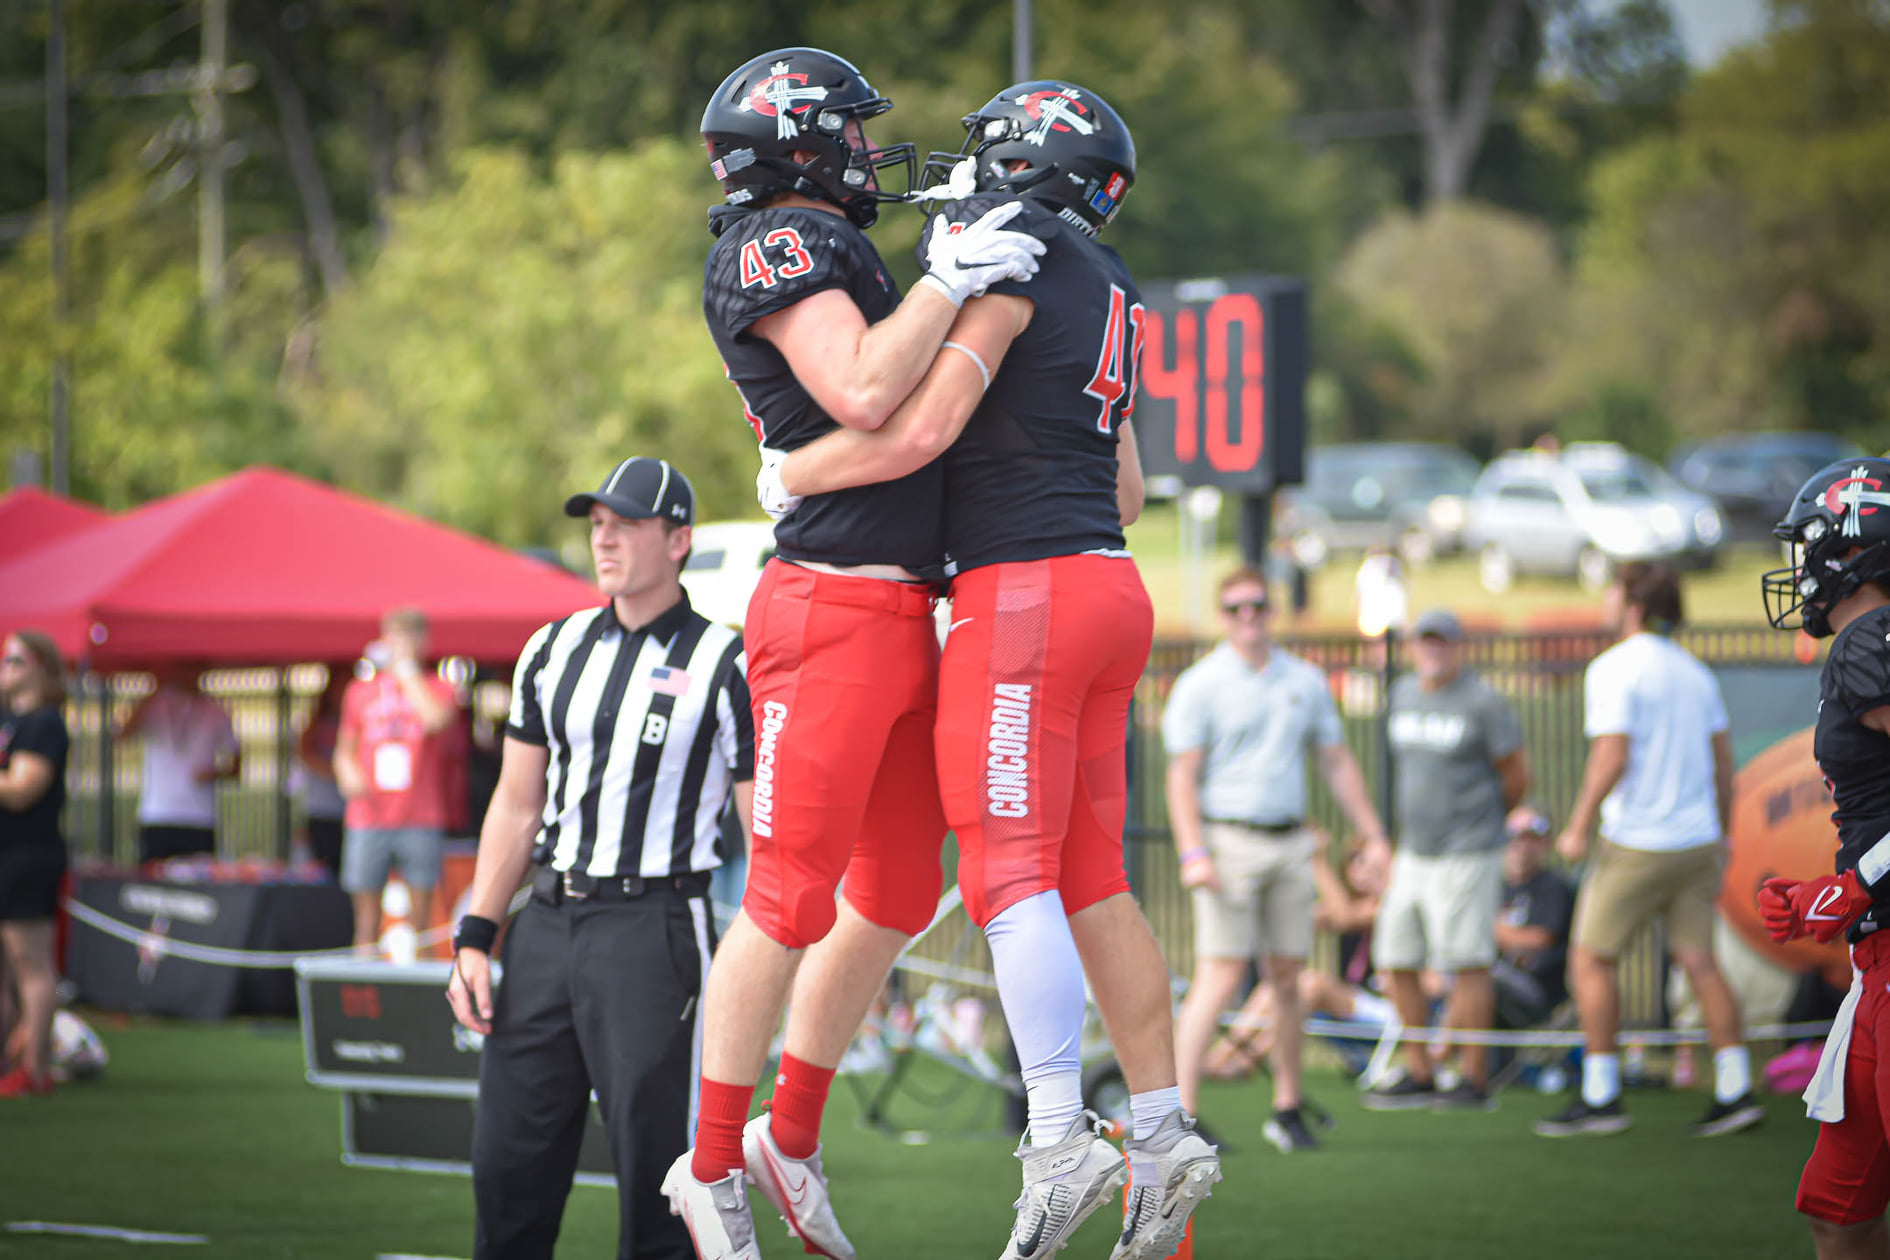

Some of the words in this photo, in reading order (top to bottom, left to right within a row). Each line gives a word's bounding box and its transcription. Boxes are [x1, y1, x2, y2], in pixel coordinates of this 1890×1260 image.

[739, 226, 815, 289] 43
[1142, 293, 1264, 473] 40
[642, 712, 668, 746] B
[752, 700, 787, 838] CONCORDIA
[987, 683, 1032, 818] CONCORDIA
